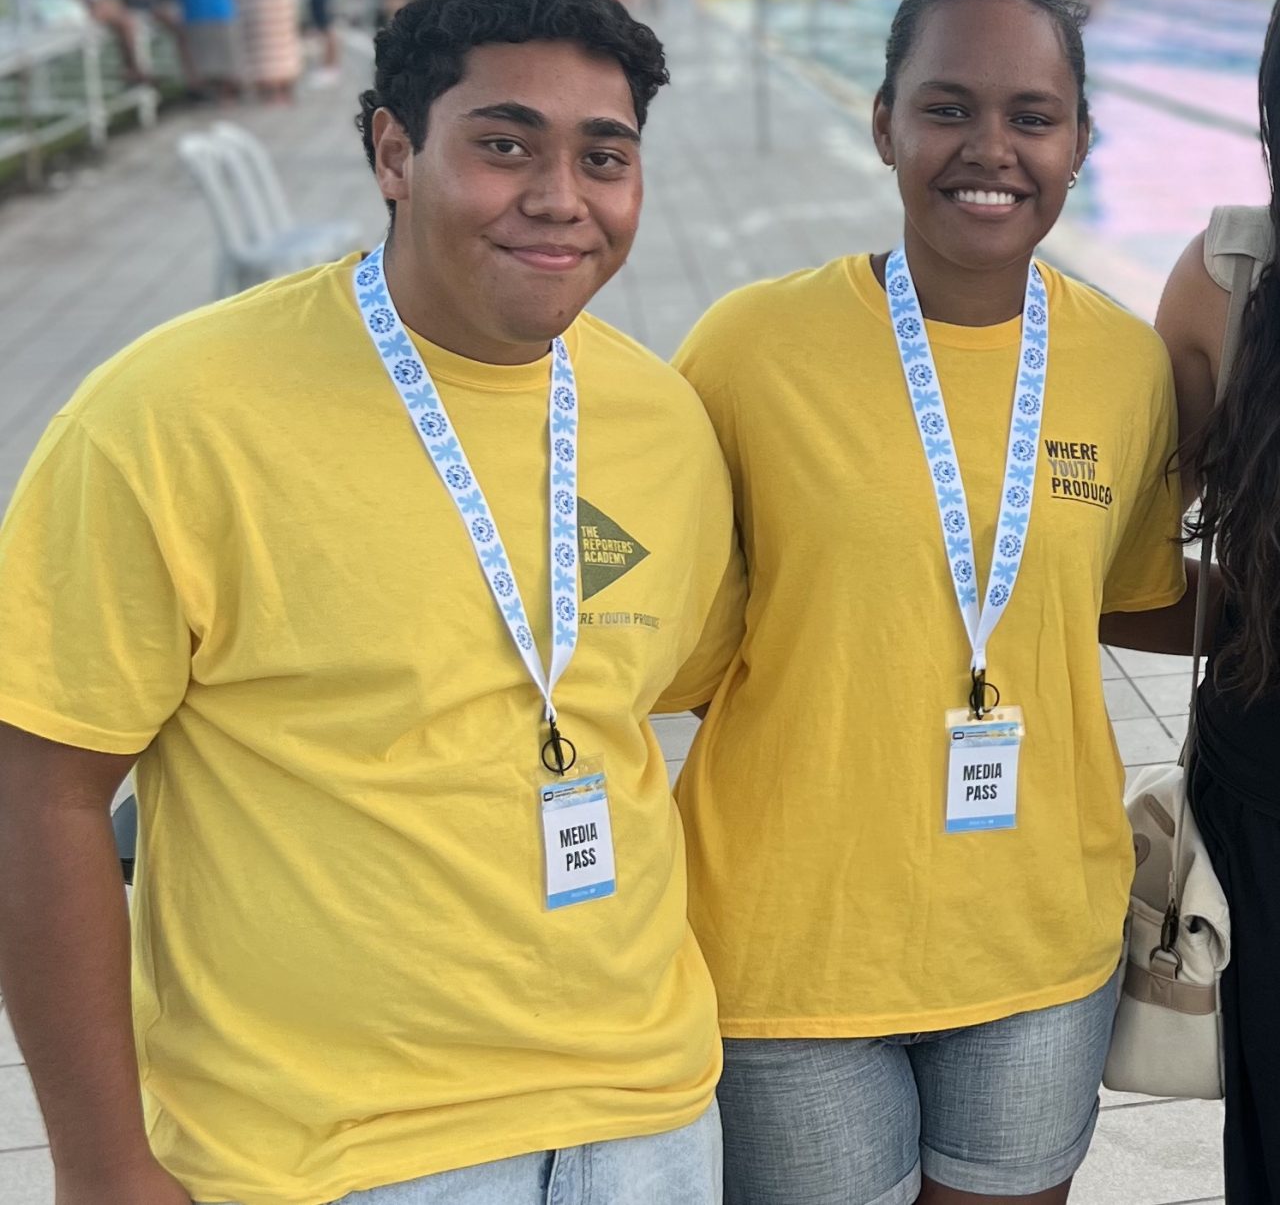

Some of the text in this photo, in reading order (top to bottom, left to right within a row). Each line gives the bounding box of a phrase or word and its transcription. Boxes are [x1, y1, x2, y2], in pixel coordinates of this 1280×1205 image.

[1044, 439, 1098, 462] WHERE
[1048, 458, 1096, 481] YOUTH
[1051, 477, 1110, 505] PRODUCE
[581, 525, 599, 538] THE
[585, 550, 626, 565] ACADEMY
[598, 612, 631, 624] YOUTH
[963, 762, 1003, 781] MEDIA
[965, 784, 998, 801] PASS
[559, 822, 598, 848] MEDIA
[566, 848, 597, 872] PASS
